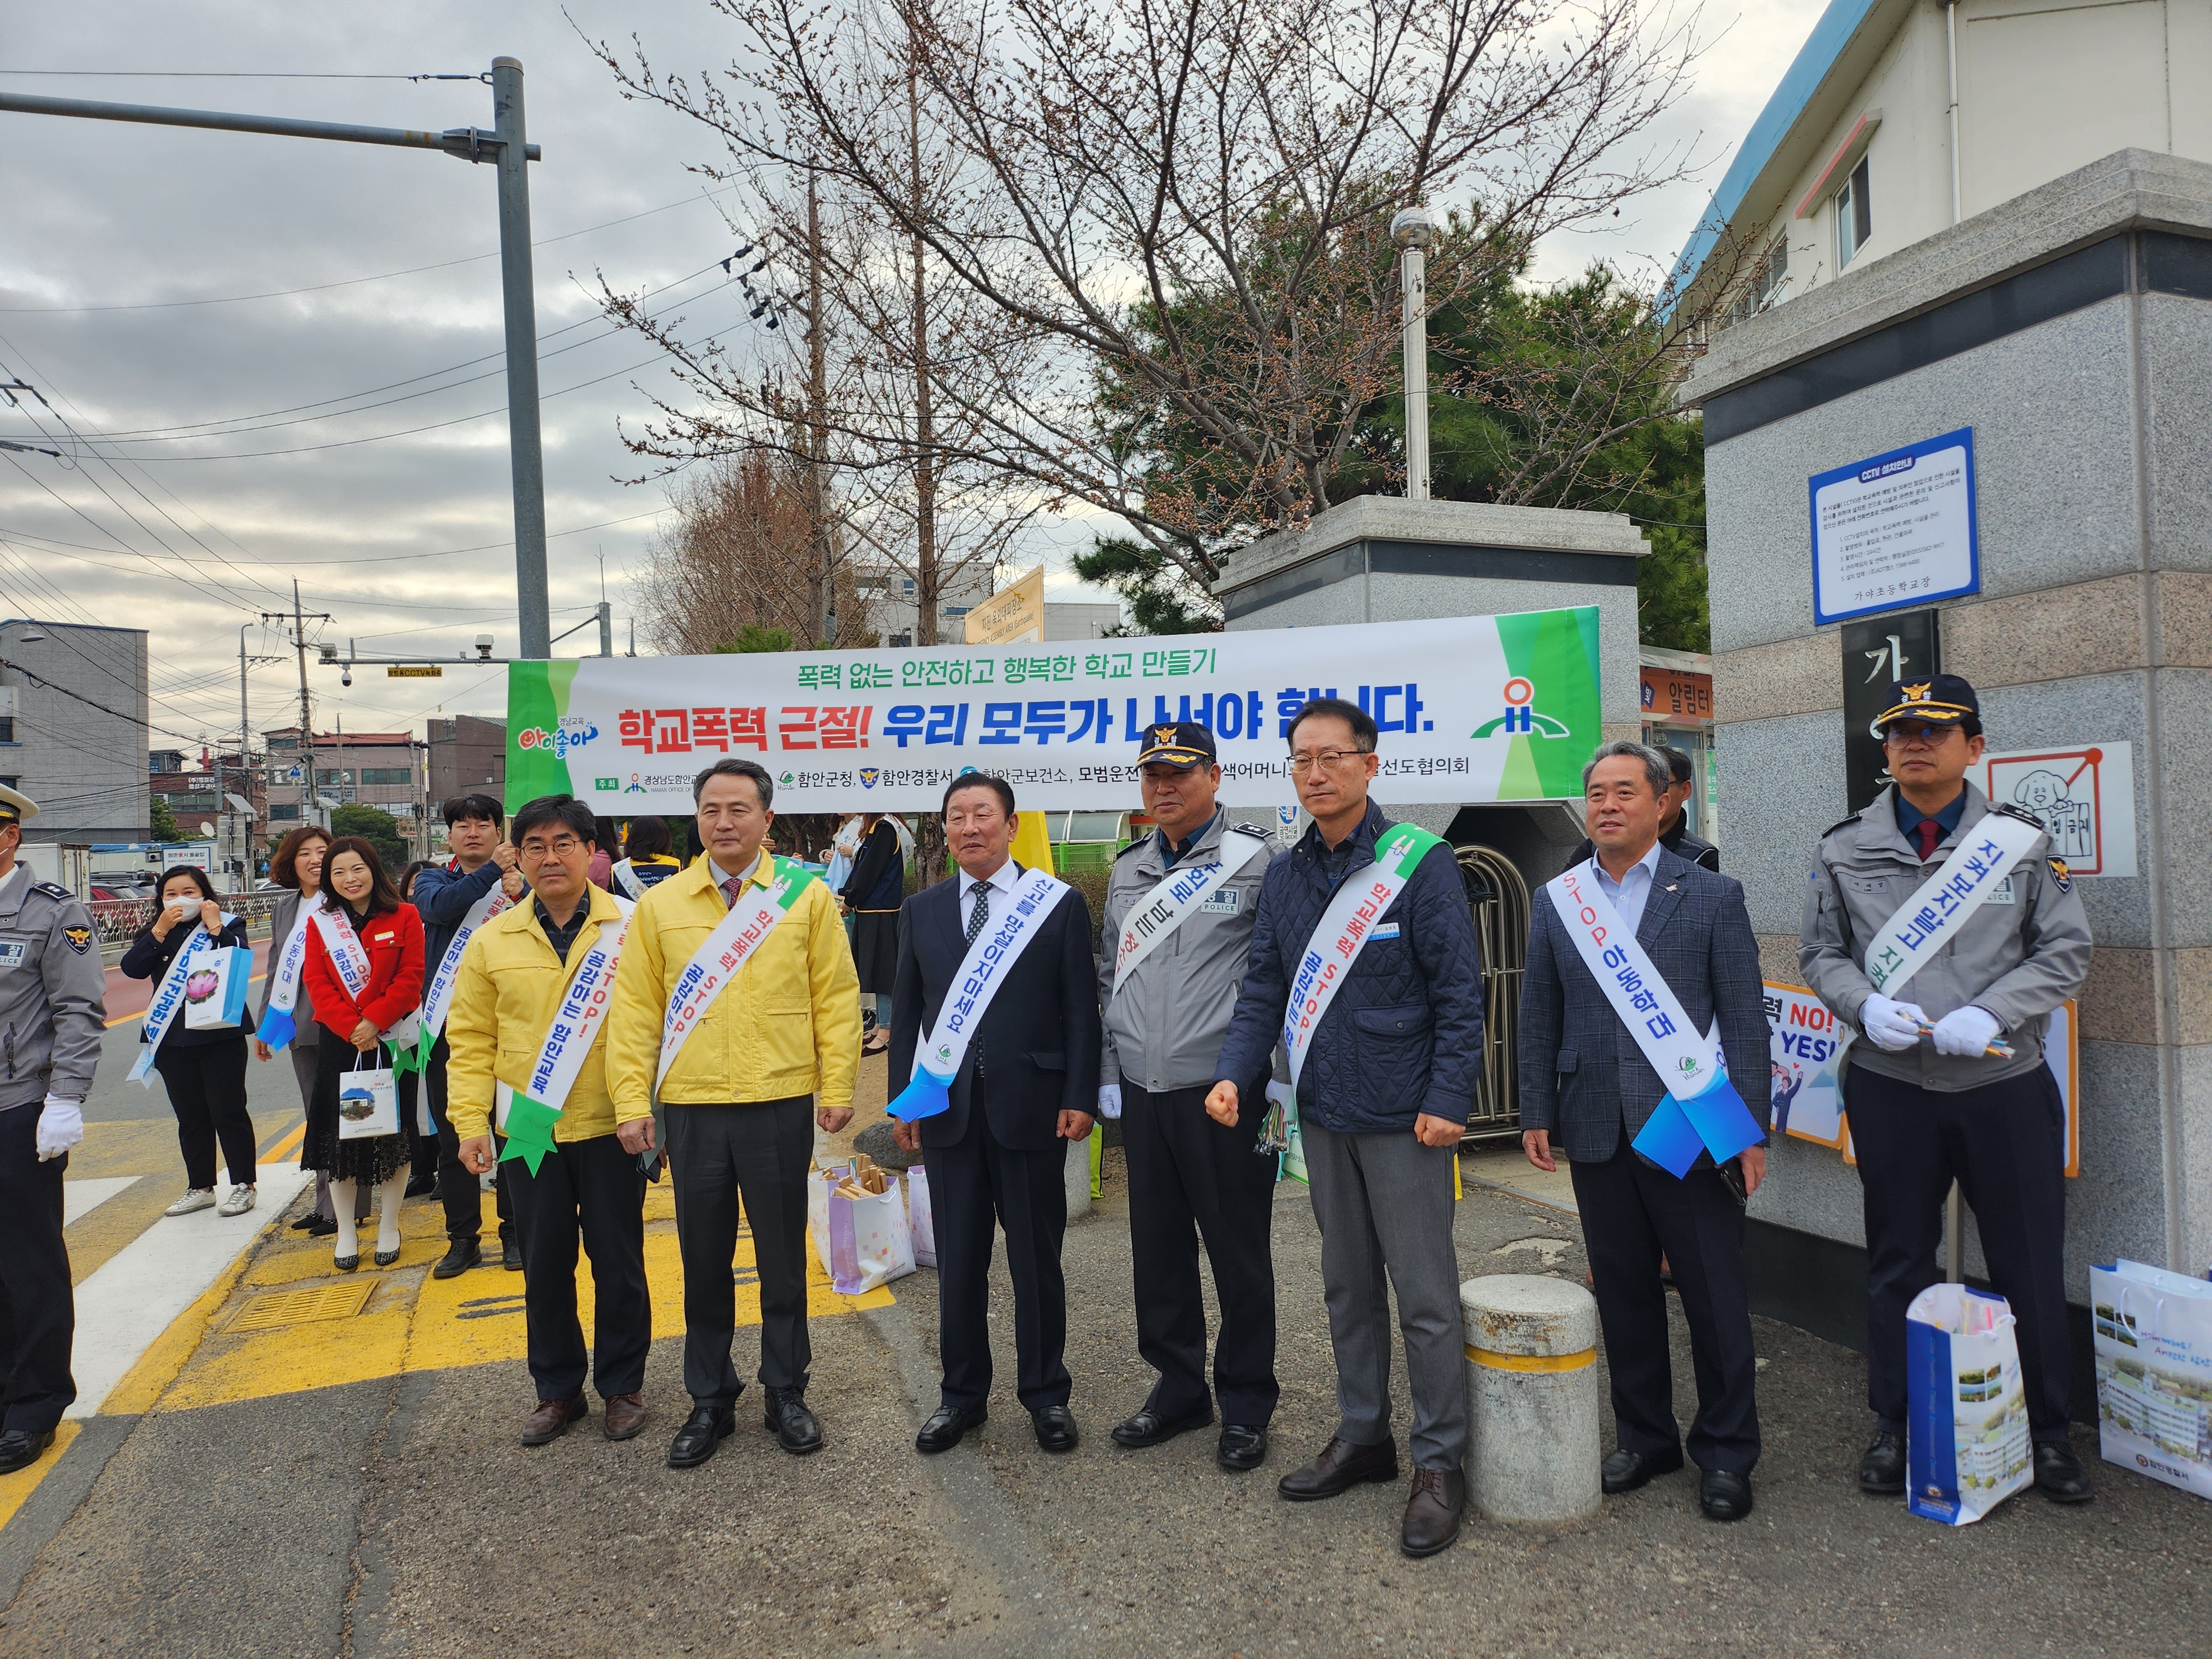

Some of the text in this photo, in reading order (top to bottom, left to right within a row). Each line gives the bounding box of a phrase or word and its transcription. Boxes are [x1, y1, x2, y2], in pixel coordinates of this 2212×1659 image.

[1861, 457, 1912, 481] CCTV 설치안내
[1838, 509, 1851, 518] 위하여
[1853, 505, 1866, 513] 설치한
[1005, 623, 1014, 634] AREA
[797, 648, 1217, 691] 폭력 없는 안전하고 행복한 학교 만들기
[1668, 681, 1710, 715] 알림터
[559, 717, 585, 726] 경남교육
[618, 706, 768, 754] 학교폭력
[778, 705, 874, 751] 근절!
[883, 702, 969, 748] 우리
[978, 699, 1113, 745] 모두가
[520, 727, 599, 758] 아이좋아
[598, 779, 615, 789] 주최
[644, 775, 698, 785] 경상남도함안교
[797, 770, 856, 788] 함안군청,
[882, 764, 953, 786] 함안경찰서
[1078, 765, 1141, 783] 모범운전
[1221, 761, 1292, 781] 색어머니
[1280, 825, 1297, 835] 금연시설
[2053, 818, 2089, 834] 입금지
[1024, 878, 1055, 917] 신고를
[1895, 839, 2005, 951] 지켜보지말고
[1134, 898, 1175, 938] 남는
[333, 948, 363, 993] 공감하는
[1296, 881, 1392, 1048] 학교폭력 STOP!
[1563, 872, 1678, 1040] STOP 아동학대
[425, 926, 472, 1025] 공감하는 함안교육
[667, 909, 774, 1050] 학교폭력 STOP!
[1288, 951, 1323, 1026] 공감하는
[665, 963, 705, 1030] 공감하는
[532, 950, 606, 1094] 공감하는 함안교육
[1789, 1001, 1835, 1034] NO!
[1781, 1030, 1836, 1062] YES!
